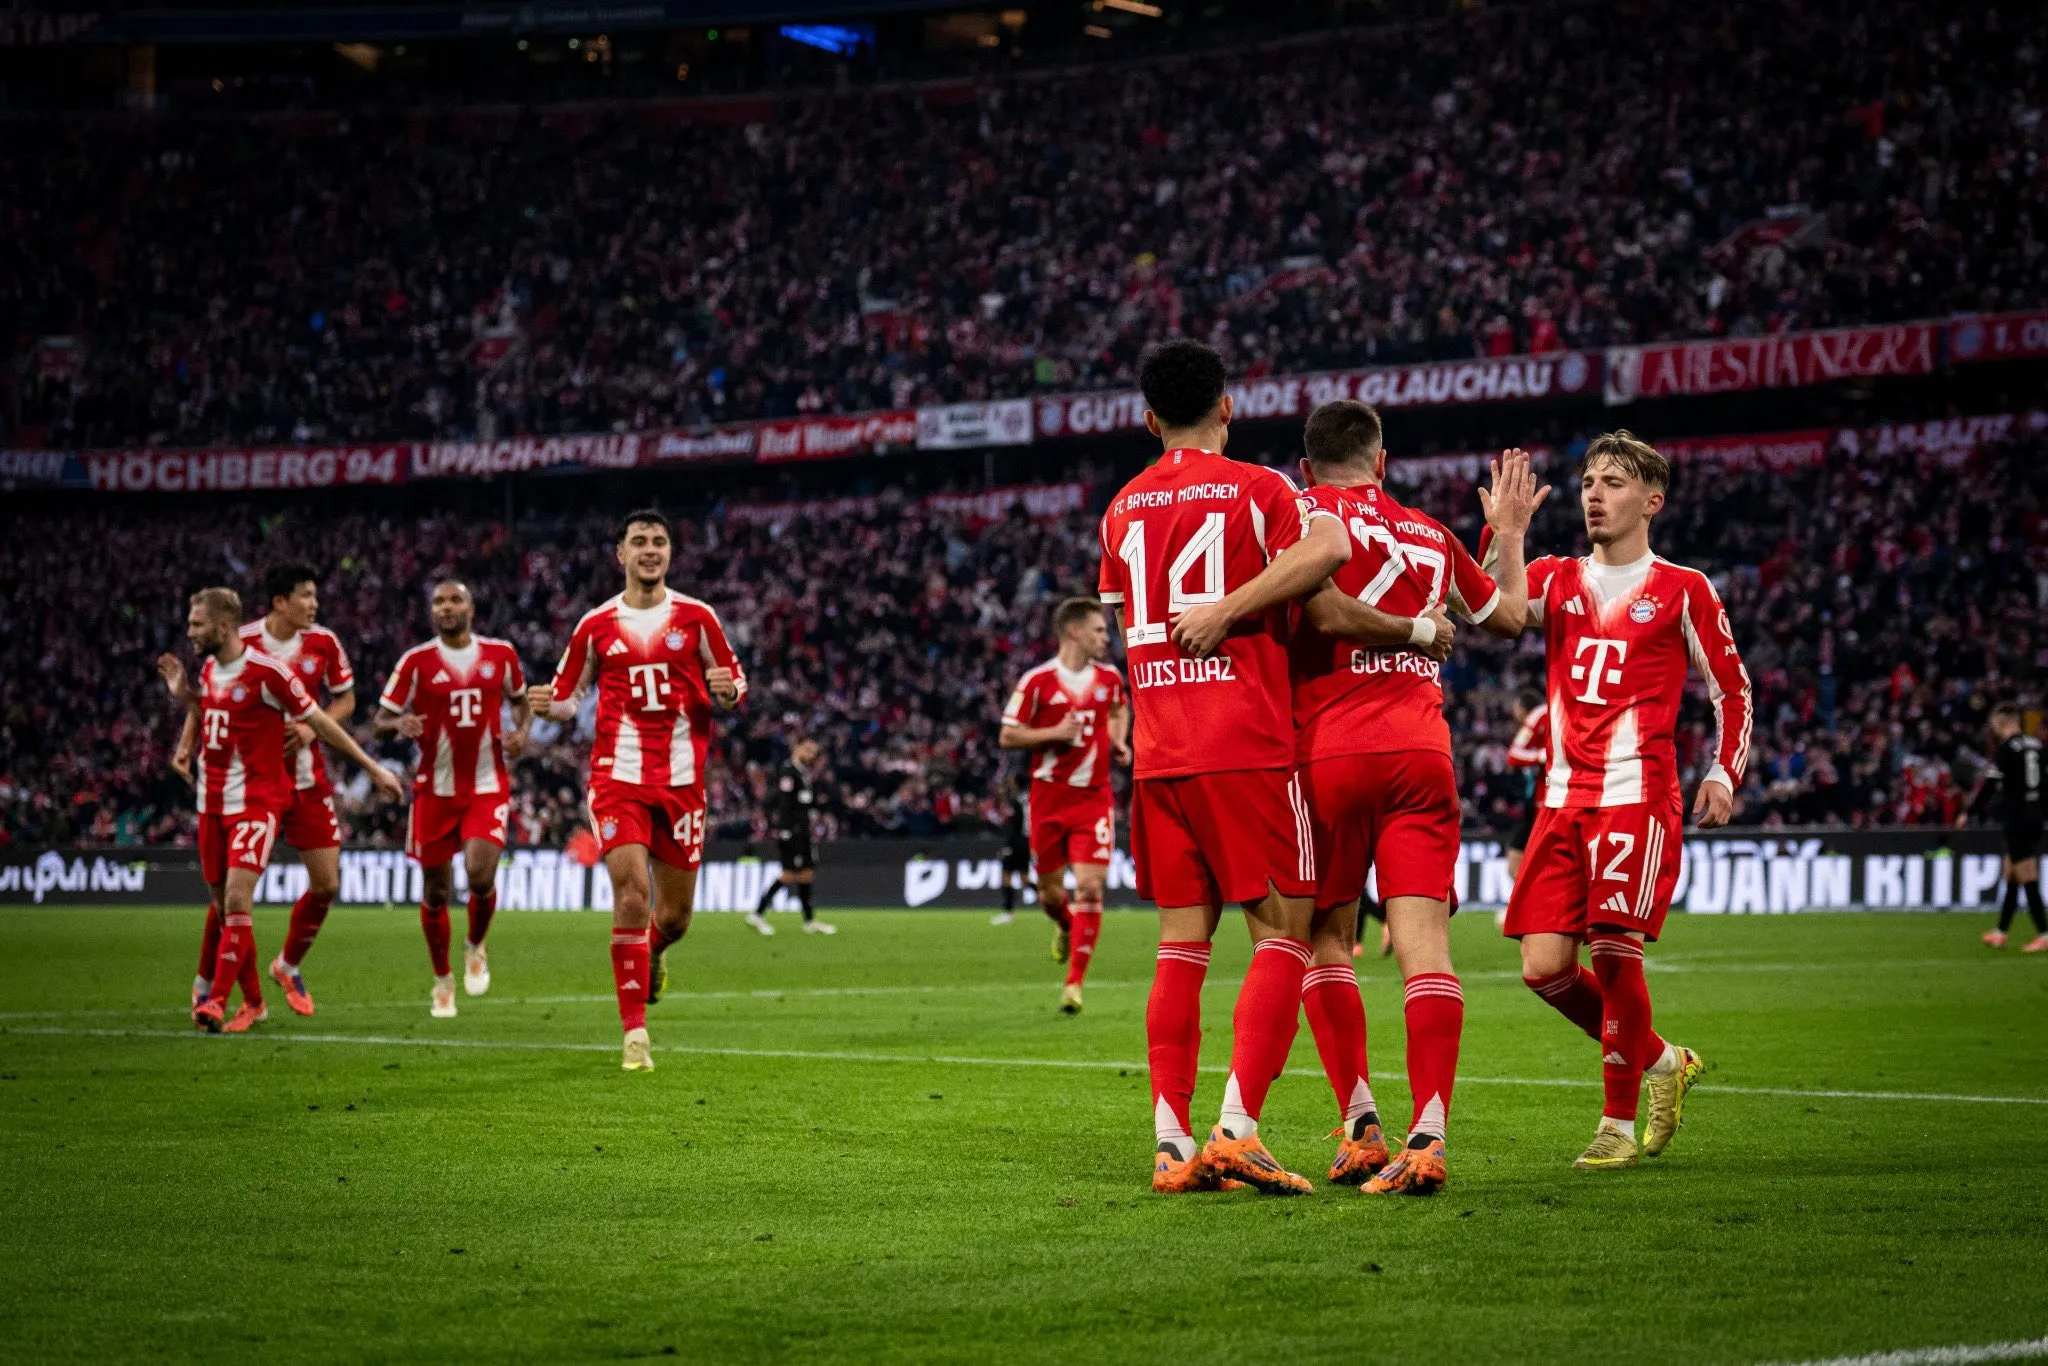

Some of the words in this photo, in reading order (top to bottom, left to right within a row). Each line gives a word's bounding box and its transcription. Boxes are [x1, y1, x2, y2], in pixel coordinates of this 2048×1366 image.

[1358, 361, 1552, 406] GLAUCHAU
[1113, 500, 1125, 517] FC
[1127, 490, 1173, 511] BAYERN
[1178, 484, 1238, 503] MÜNCHEN
[1118, 512, 1225, 648] 14
[629, 662, 671, 711] T
[1571, 637, 1627, 705] T
[450, 688, 482, 727] T
[204, 708, 229, 749] T
[232, 820, 267, 850] 27
[673, 808, 704, 846] 45
[1095, 817, 1110, 845] 6
[1588, 832, 1635, 882] 12
